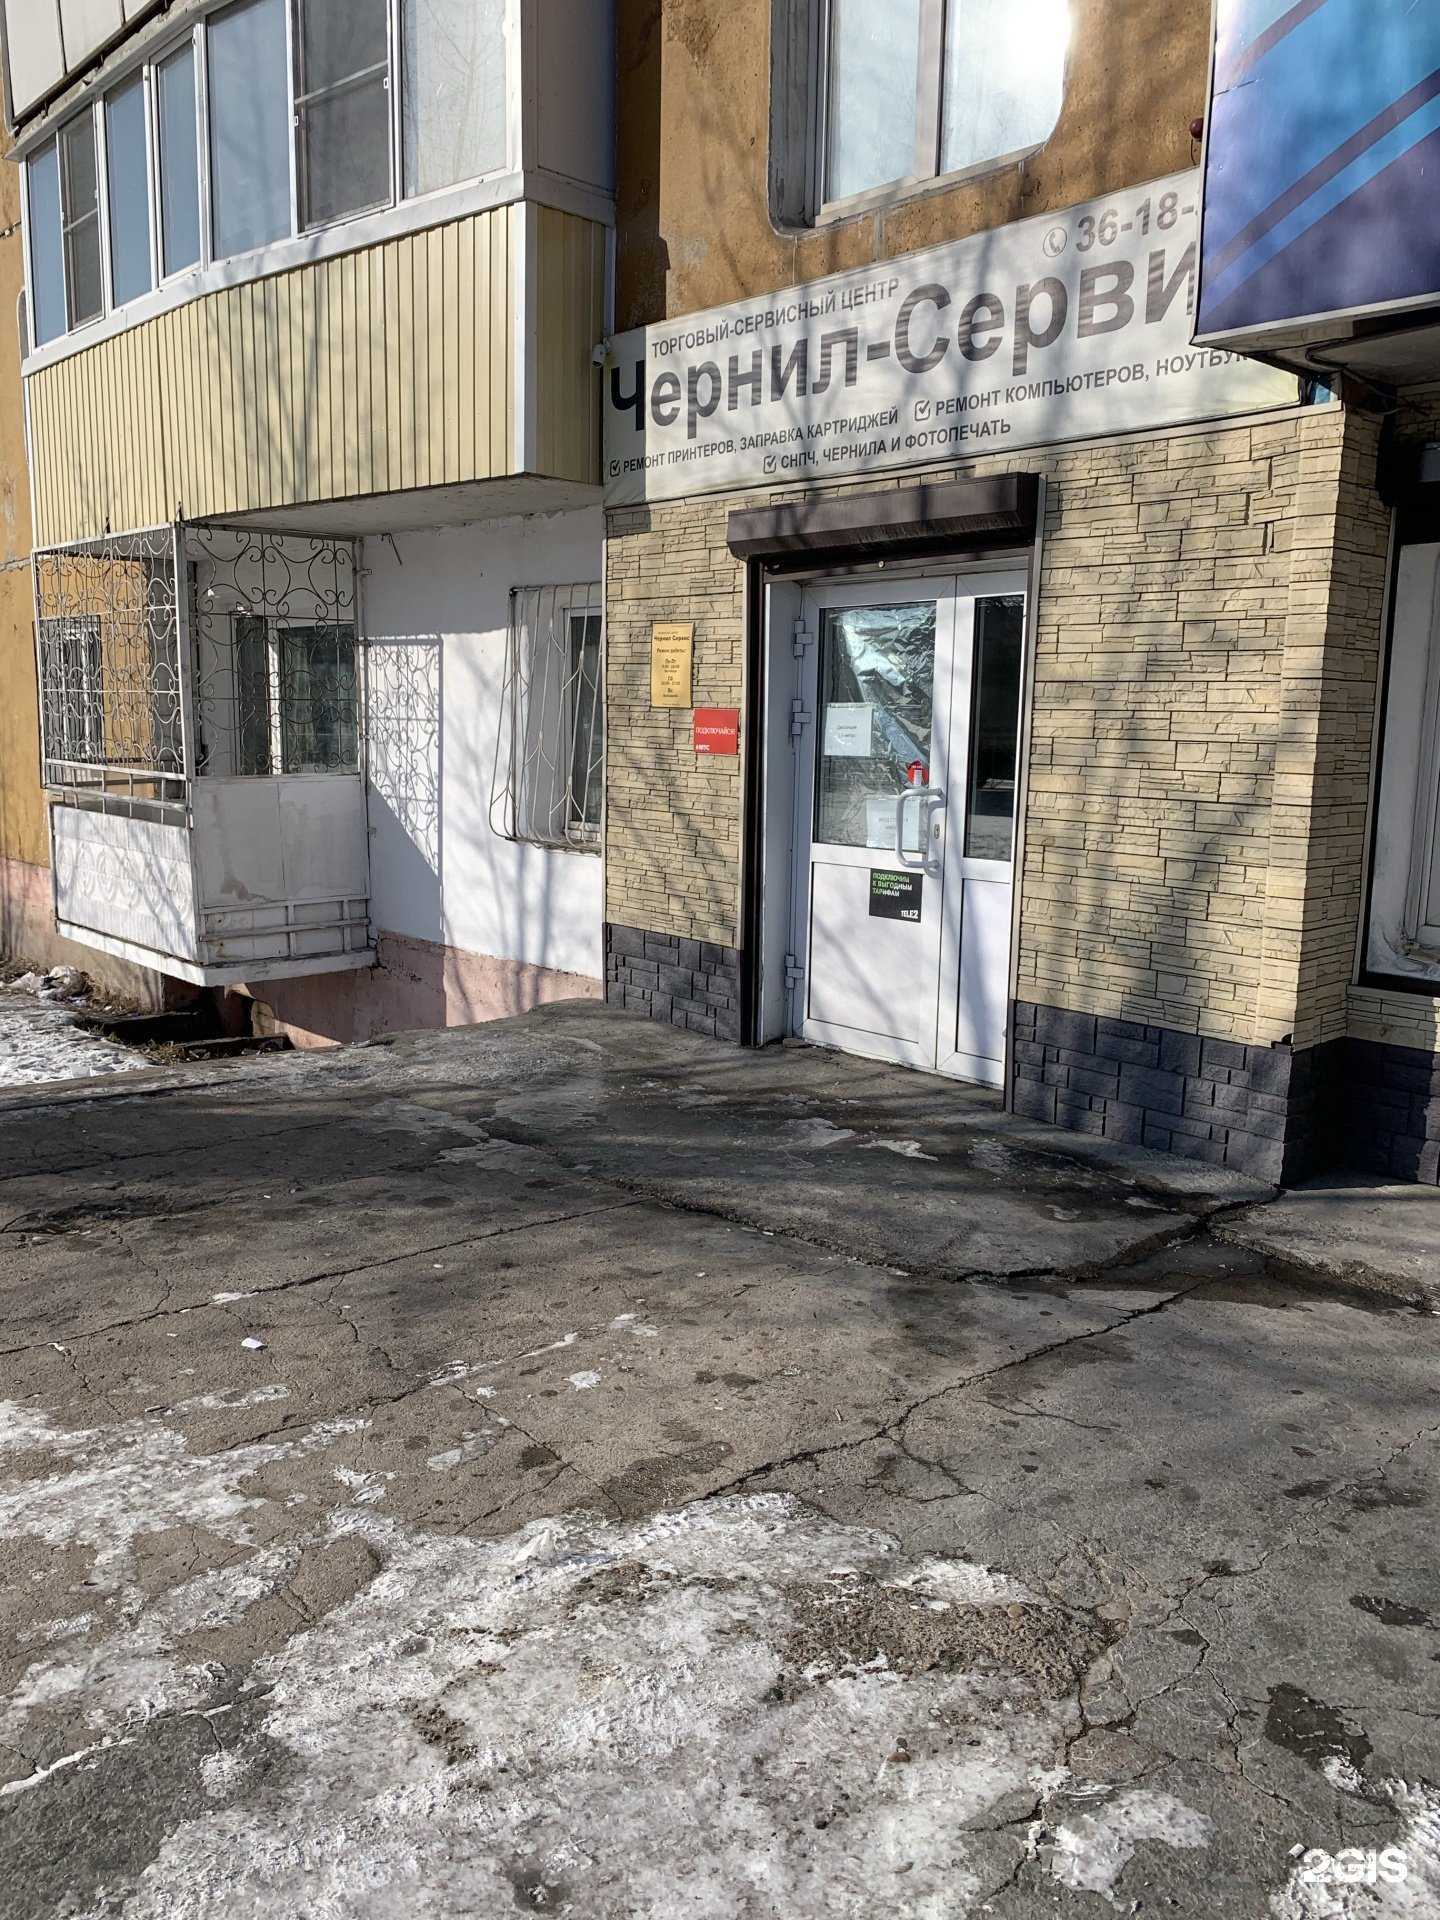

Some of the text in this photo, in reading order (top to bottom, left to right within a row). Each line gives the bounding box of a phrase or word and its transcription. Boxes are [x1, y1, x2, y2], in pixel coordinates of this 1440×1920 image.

[1075, 191, 1198, 253] 36-18-
[610, 241, 1197, 439] Чернил-Серви
[652, 277, 900, 358] ТОРГОВЫЙ-СЕРВИСНЫЙ ЦЕНТР
[623, 453, 665, 472] РЕМОНТ
[668, 440, 737, 467] ПРИНТЕРОВ,
[740, 426, 804, 450] ЗАПРАВКА
[807, 405, 899, 440] КАРТРИДЖЕЙ
[935, 390, 1001, 416] РЕМОНТ
[1005, 363, 1150, 403] КОМПЬЮТЕРОВ,
[781, 419, 1011, 469] СНПЧ, ЧЕРНИЛА И ФОТОПЕЧАТЬ
[901, 910, 919, 919] TELE2
